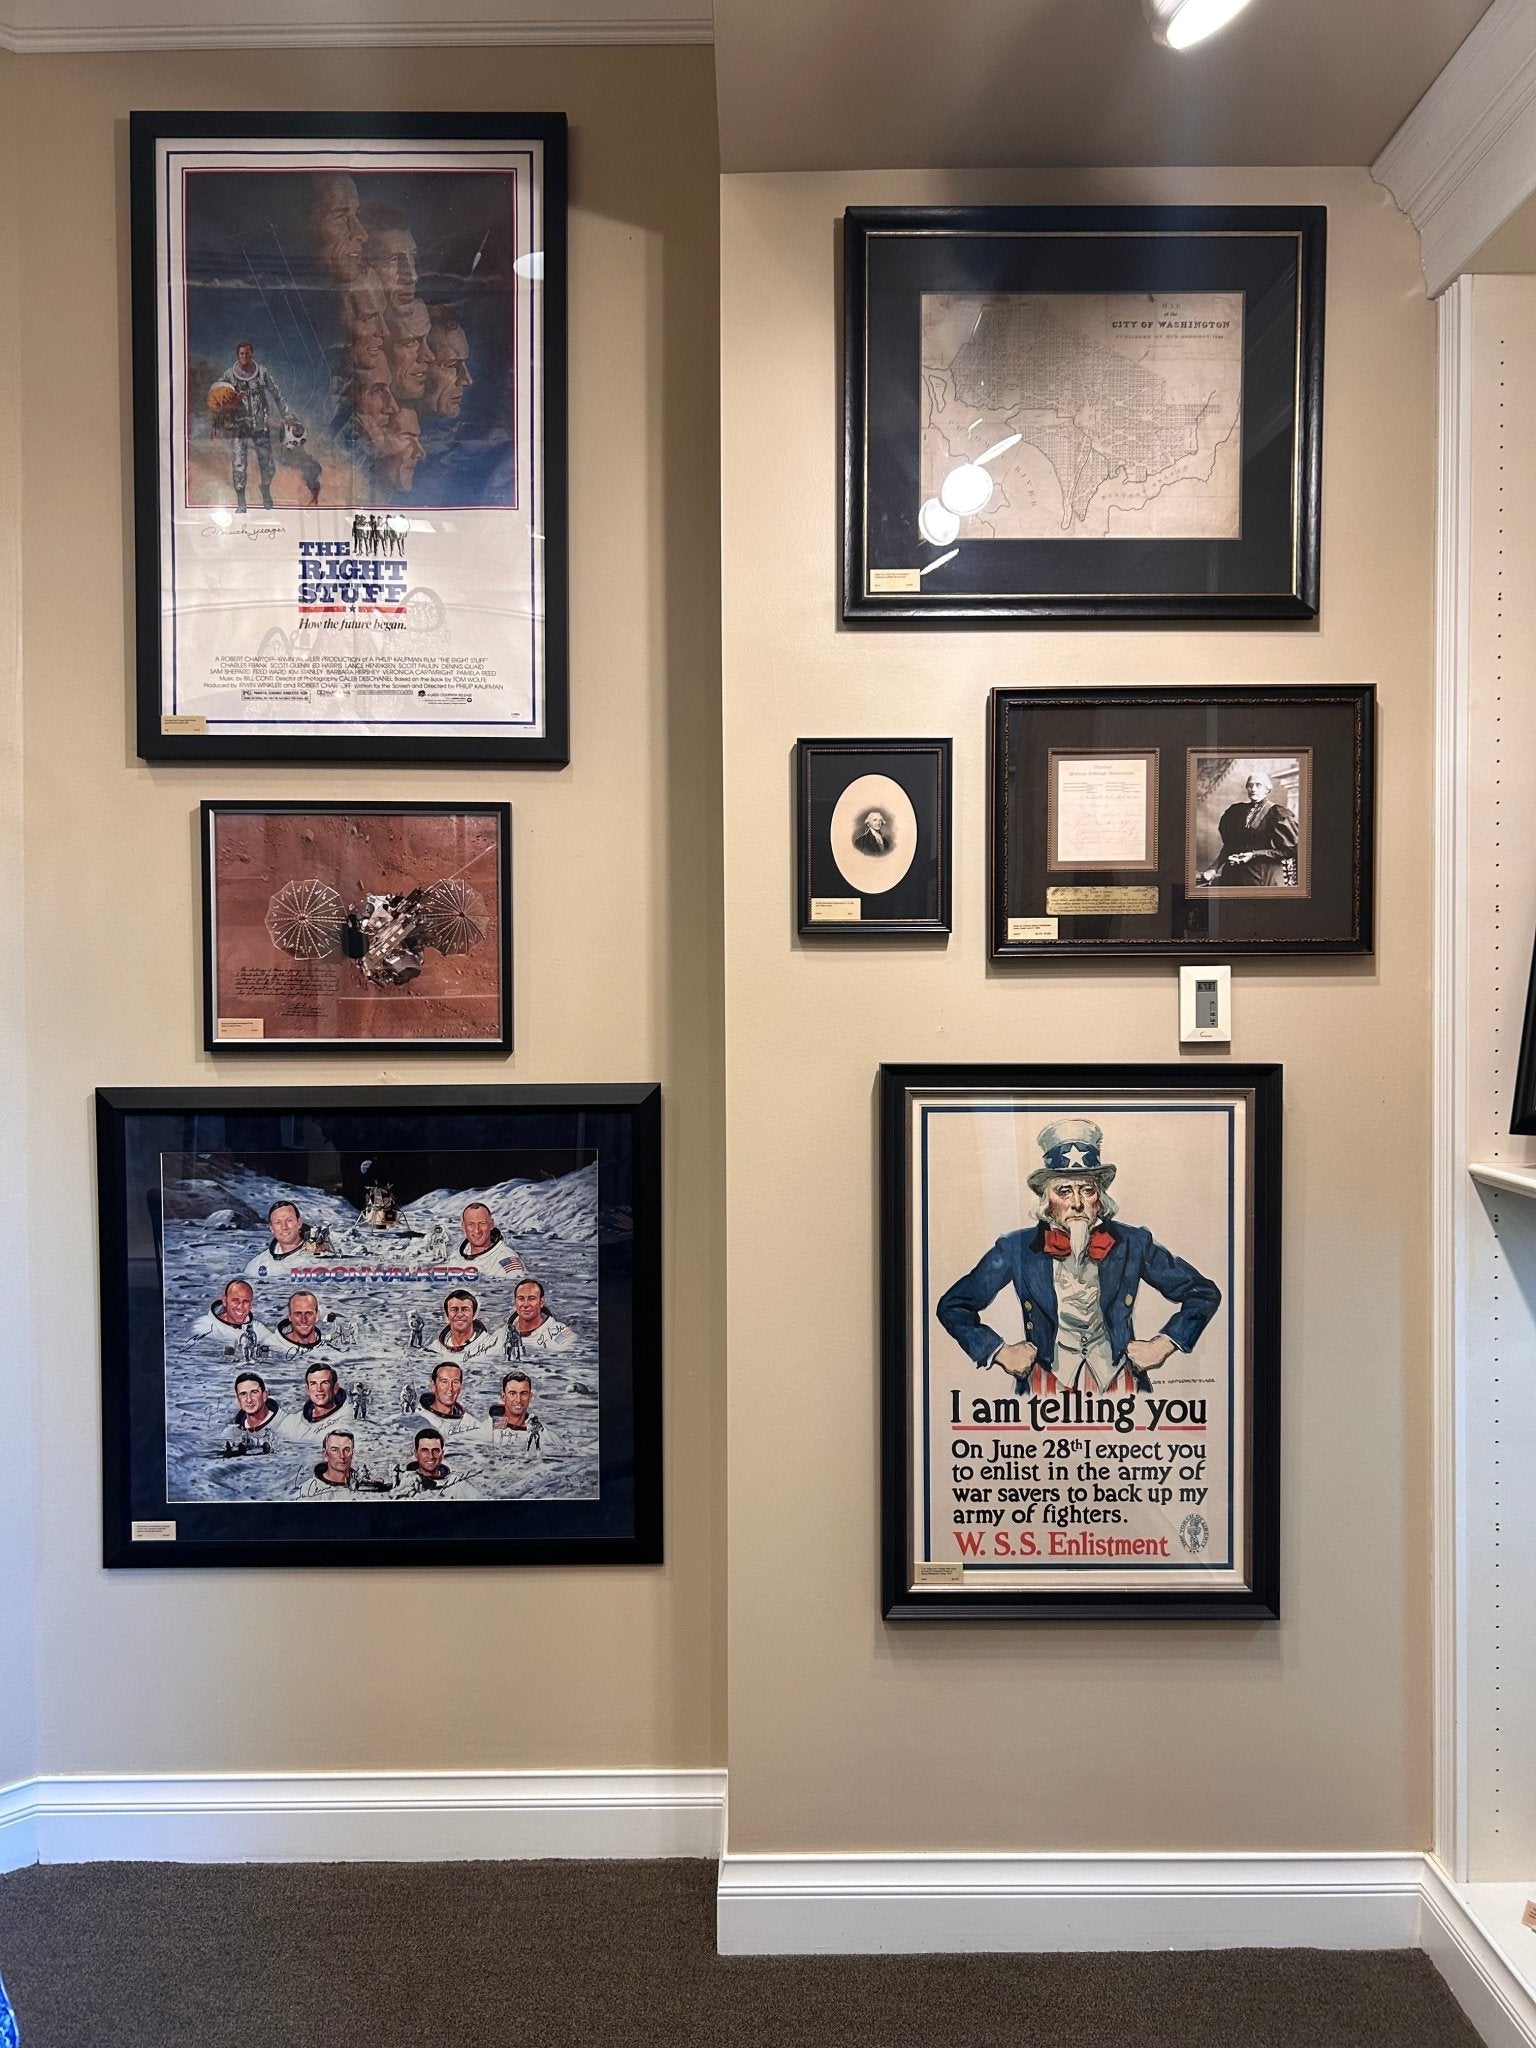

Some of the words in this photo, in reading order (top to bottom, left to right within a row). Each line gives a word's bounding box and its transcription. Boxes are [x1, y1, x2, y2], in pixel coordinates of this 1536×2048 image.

[298, 541, 350, 556] THE
[298, 559, 408, 580] RIGHT
[298, 582, 408, 603] STUFF
[299, 618, 323, 629] How
[323, 618, 339, 629] the
[339, 618, 372, 631] future
[373, 618, 407, 631] began.
[290, 1265, 480, 1282] MOONWALKERS
[950, 1389, 962, 1423] I
[972, 1398, 1021, 1423] am
[1027, 1390, 1136, 1433] telling
[1144, 1399, 1207, 1431] you
[951, 1439, 984, 1458] On
[986, 1439, 1038, 1463] June
[1083, 1440, 1092, 1459] I
[1095, 1441, 1163, 1462] expect
[1167, 1444, 1206, 1462] you
[952, 1464, 974, 1482] to
[980, 1461, 1041, 1481] enlist
[1047, 1461, 1069, 1480] in
[1076, 1462, 1111, 1481] the
[1118, 1466, 1173, 1485] army
[1178, 1459, 1207, 1480] of
[952, 1488, 992, 1502] war
[998, 1488, 1060, 1502] savers
[1066, 1486, 1088, 1503] to
[1092, 1483, 1143, 1502] back
[1147, 1487, 1173, 1505] up
[1179, 1487, 1209, 1505] my
[953, 1509, 1005, 1527] army
[1011, 1502, 1038, 1523] of
[1042, 1503, 1128, 1528] fighters.
[1047, 1531, 1171, 1557] Enlistment
